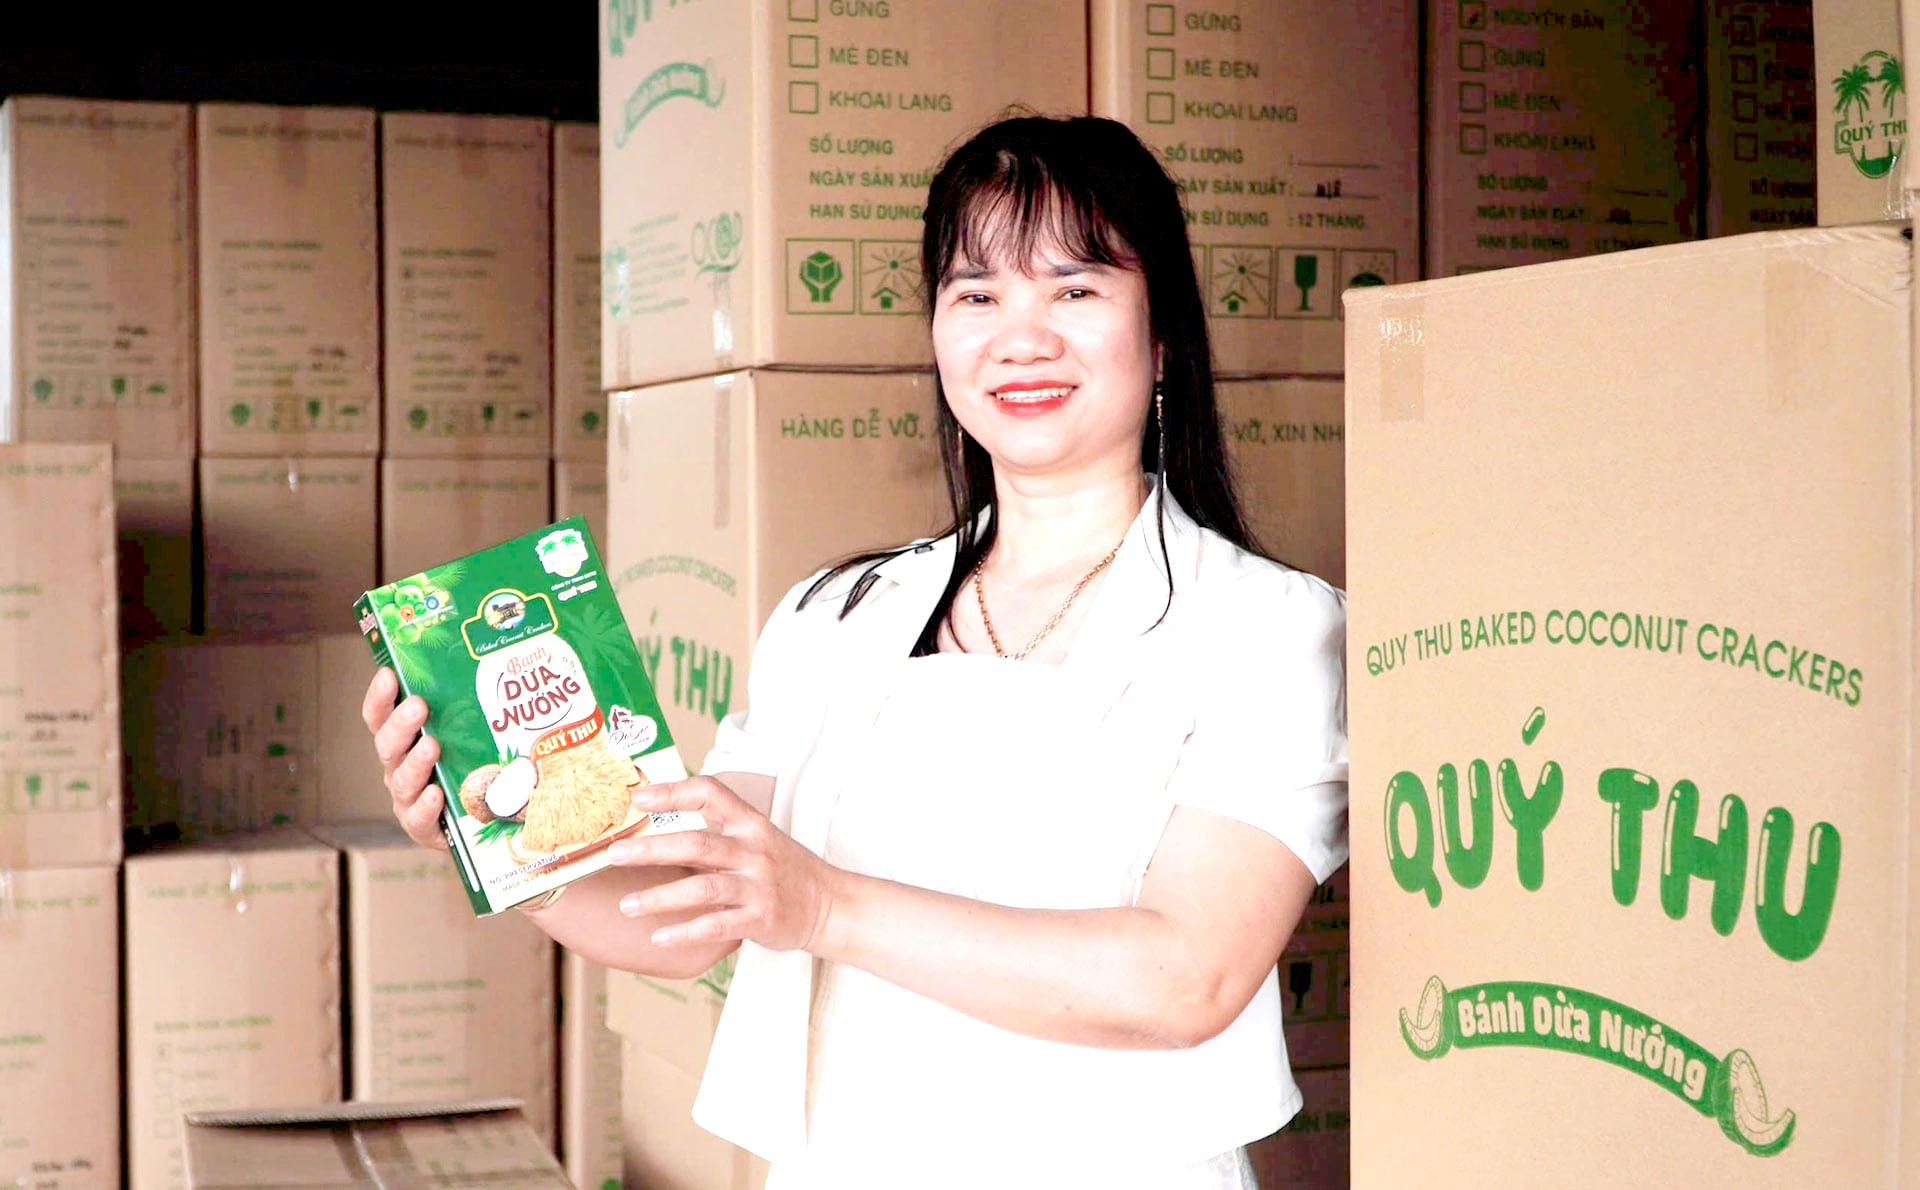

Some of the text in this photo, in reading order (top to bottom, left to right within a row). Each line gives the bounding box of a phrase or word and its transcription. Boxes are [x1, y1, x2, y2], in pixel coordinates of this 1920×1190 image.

[830, 91, 952, 112] KHOAI LANG
[1184, 101, 1297, 122] KHOAI LANG
[809, 133, 893, 156] SỐ LƯỢNG
[1840, 120, 1873, 146] QUÝ
[1164, 143, 1243, 164] SỐ LƯỢNG
[899, 168, 931, 187] XUẤ
[781, 413, 844, 438] HÀNG
[853, 407, 881, 438] DỄ
[1273, 423, 1306, 441] XIN
[1313, 422, 1344, 442] NH
[1366, 609, 1863, 707] QUY THU BAKED COCONUT CRACKERS
[671, 636, 732, 725] THU
[536, 728, 569, 755] QUÝ
[570, 718, 598, 745] THU
[1384, 706, 1842, 962] QUÝ THU
[505, 853, 557, 879] PRESERVATIVE
[1458, 989, 1707, 1101] Bánh Dừa Nướng
